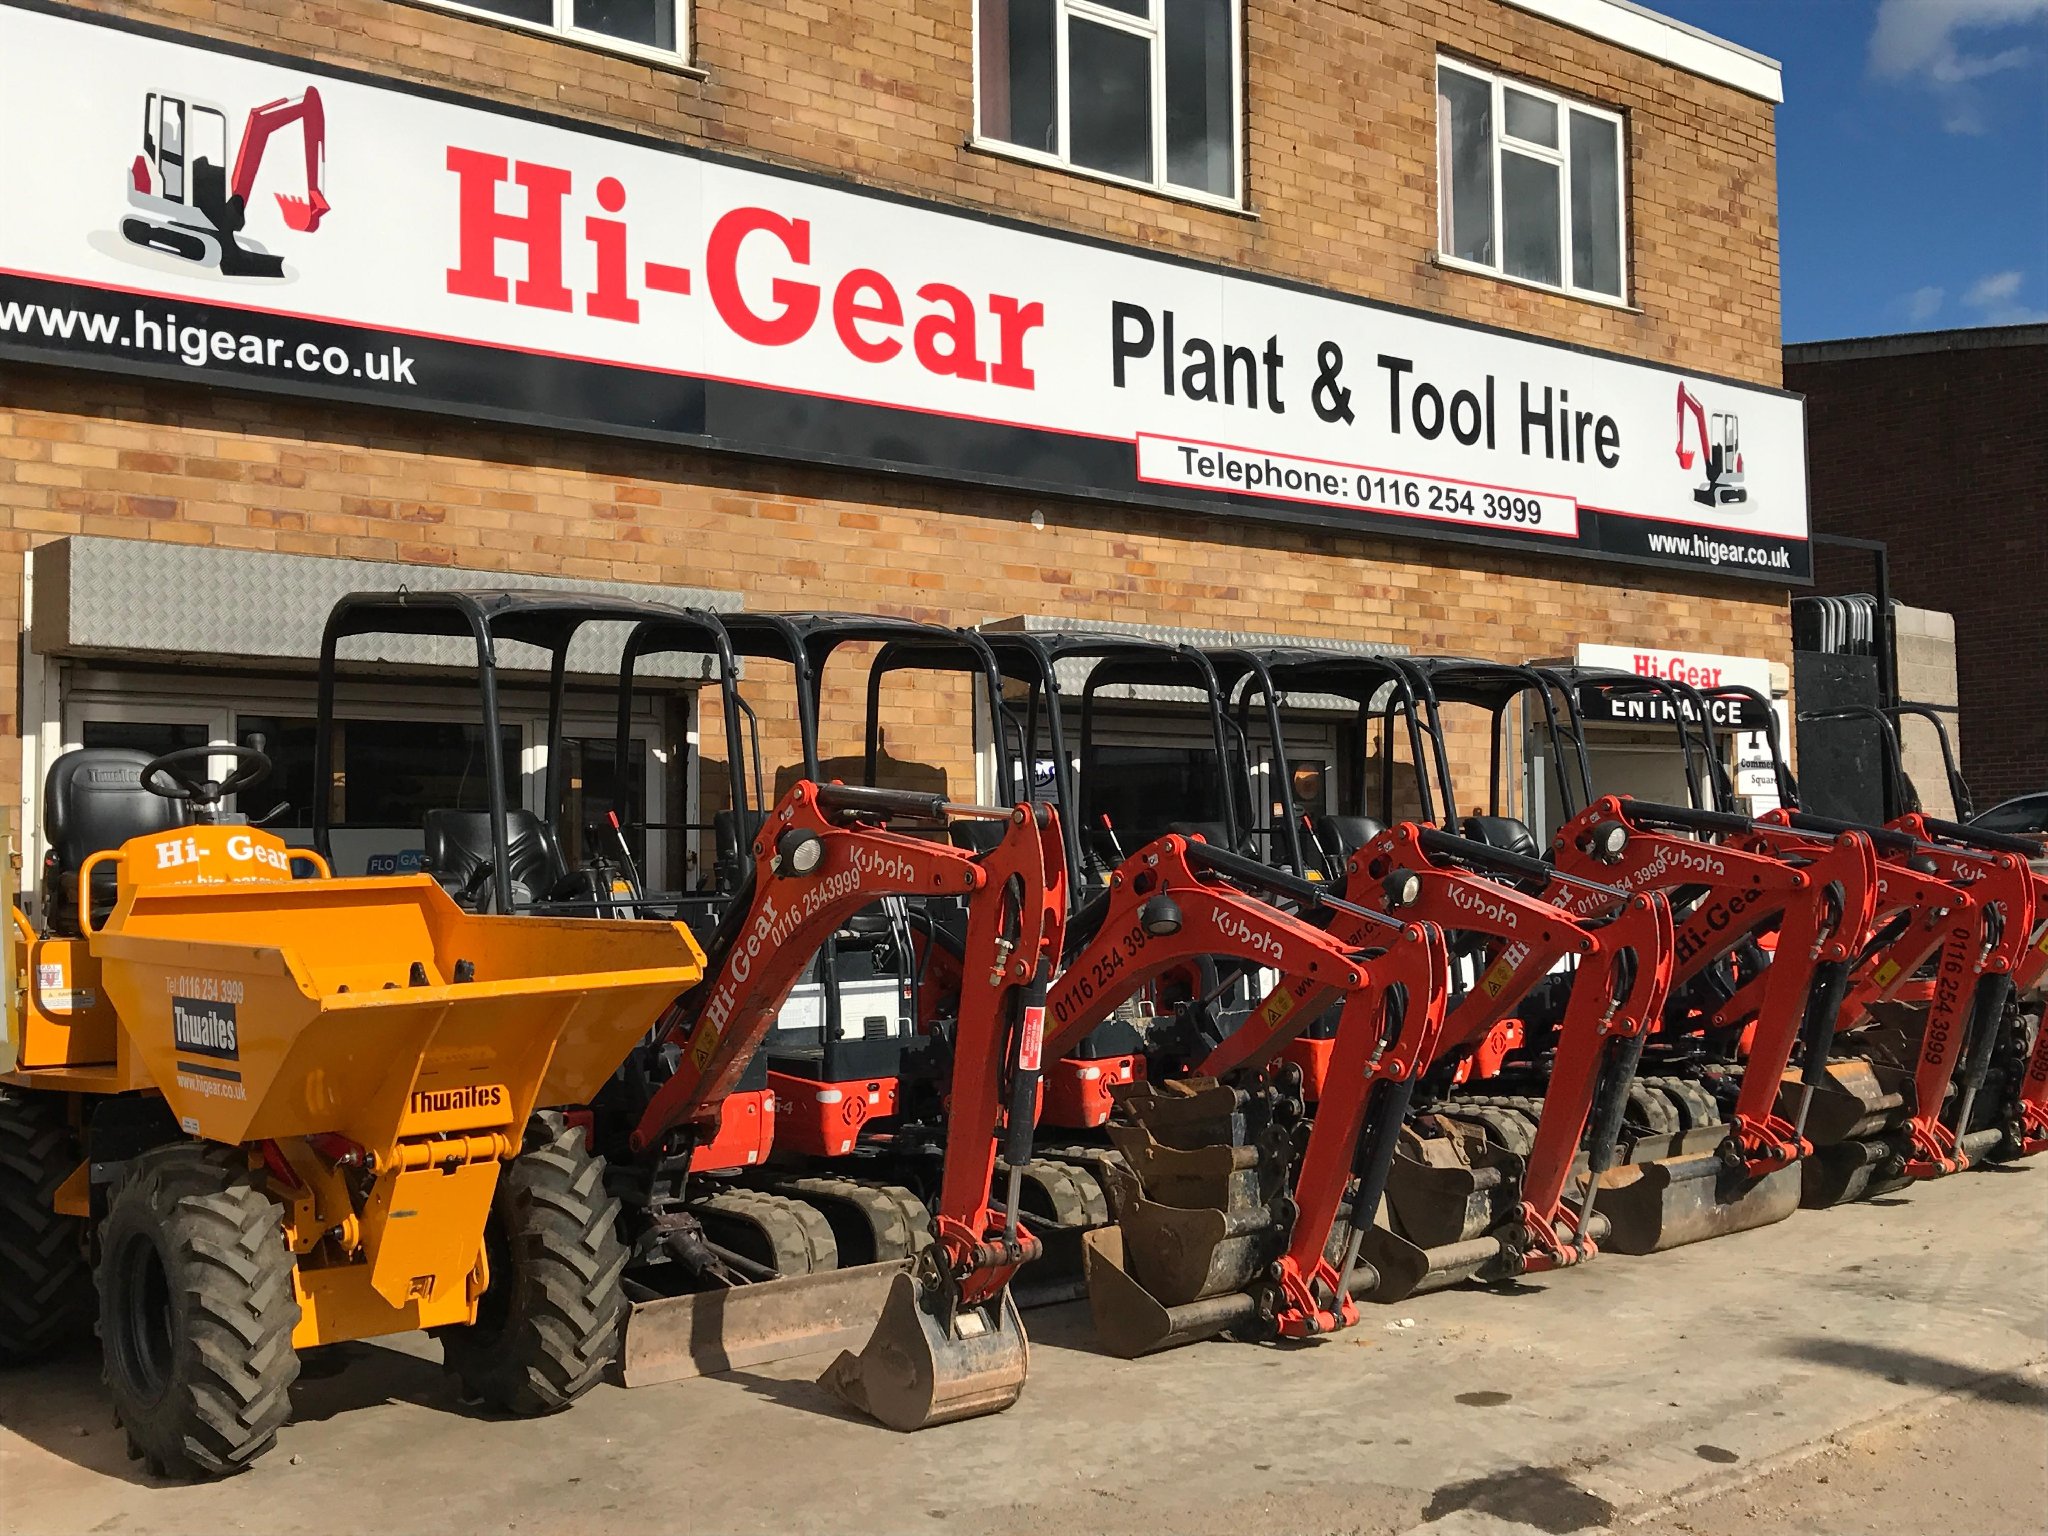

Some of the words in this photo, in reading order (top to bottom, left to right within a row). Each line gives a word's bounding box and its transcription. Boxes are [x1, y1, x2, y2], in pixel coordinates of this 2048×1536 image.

[446, 145, 1044, 391] Hi-Gear
[1112, 300, 1285, 414] Plant
[1311, 340, 1355, 426] &
[1377, 353, 1496, 450] Tool
[1520, 381, 1621, 469] Hire
[0, 301, 417, 385] www.higear.co.uk
[1177, 446, 1349, 499] Telephone:
[1356, 474, 1418, 508] 0116
[1427, 484, 1475, 516] 254
[1483, 496, 1543, 525] 3999
[1648, 533, 1791, 569] www.higear.co.uk
[1633, 654, 1722, 689] Hi-Gear
[227, 835, 288, 871] Gear
[371, 860, 394, 871] FLO
[850, 845, 914, 883] Kubota
[1633, 858, 1667, 885] 3999
[1654, 844, 1725, 875] Kubota
[771, 904, 802, 947] 0116
[1448, 883, 1518, 929] Kubota
[1676, 888, 1764, 966] Hi-Gea
[1212, 906, 1283, 960] Kubota
[1945, 927, 1971, 974] 0116
[706, 896, 778, 1035] Hi-Gear
[1054, 976, 1094, 1023] 0116
[1092, 947, 1124, 986] 254
[1123, 925, 1153, 957] 39
[202, 978, 218, 1002] 254
[220, 979, 244, 1004] 3999
[1937, 979, 1960, 1017] 254
[174, 1006, 236, 1051] Thwaites
[1926, 1018, 1950, 1066] 3999
[177, 1074, 247, 1101] www.higear.co.uk
[411, 1085, 501, 1114] Thwaites
